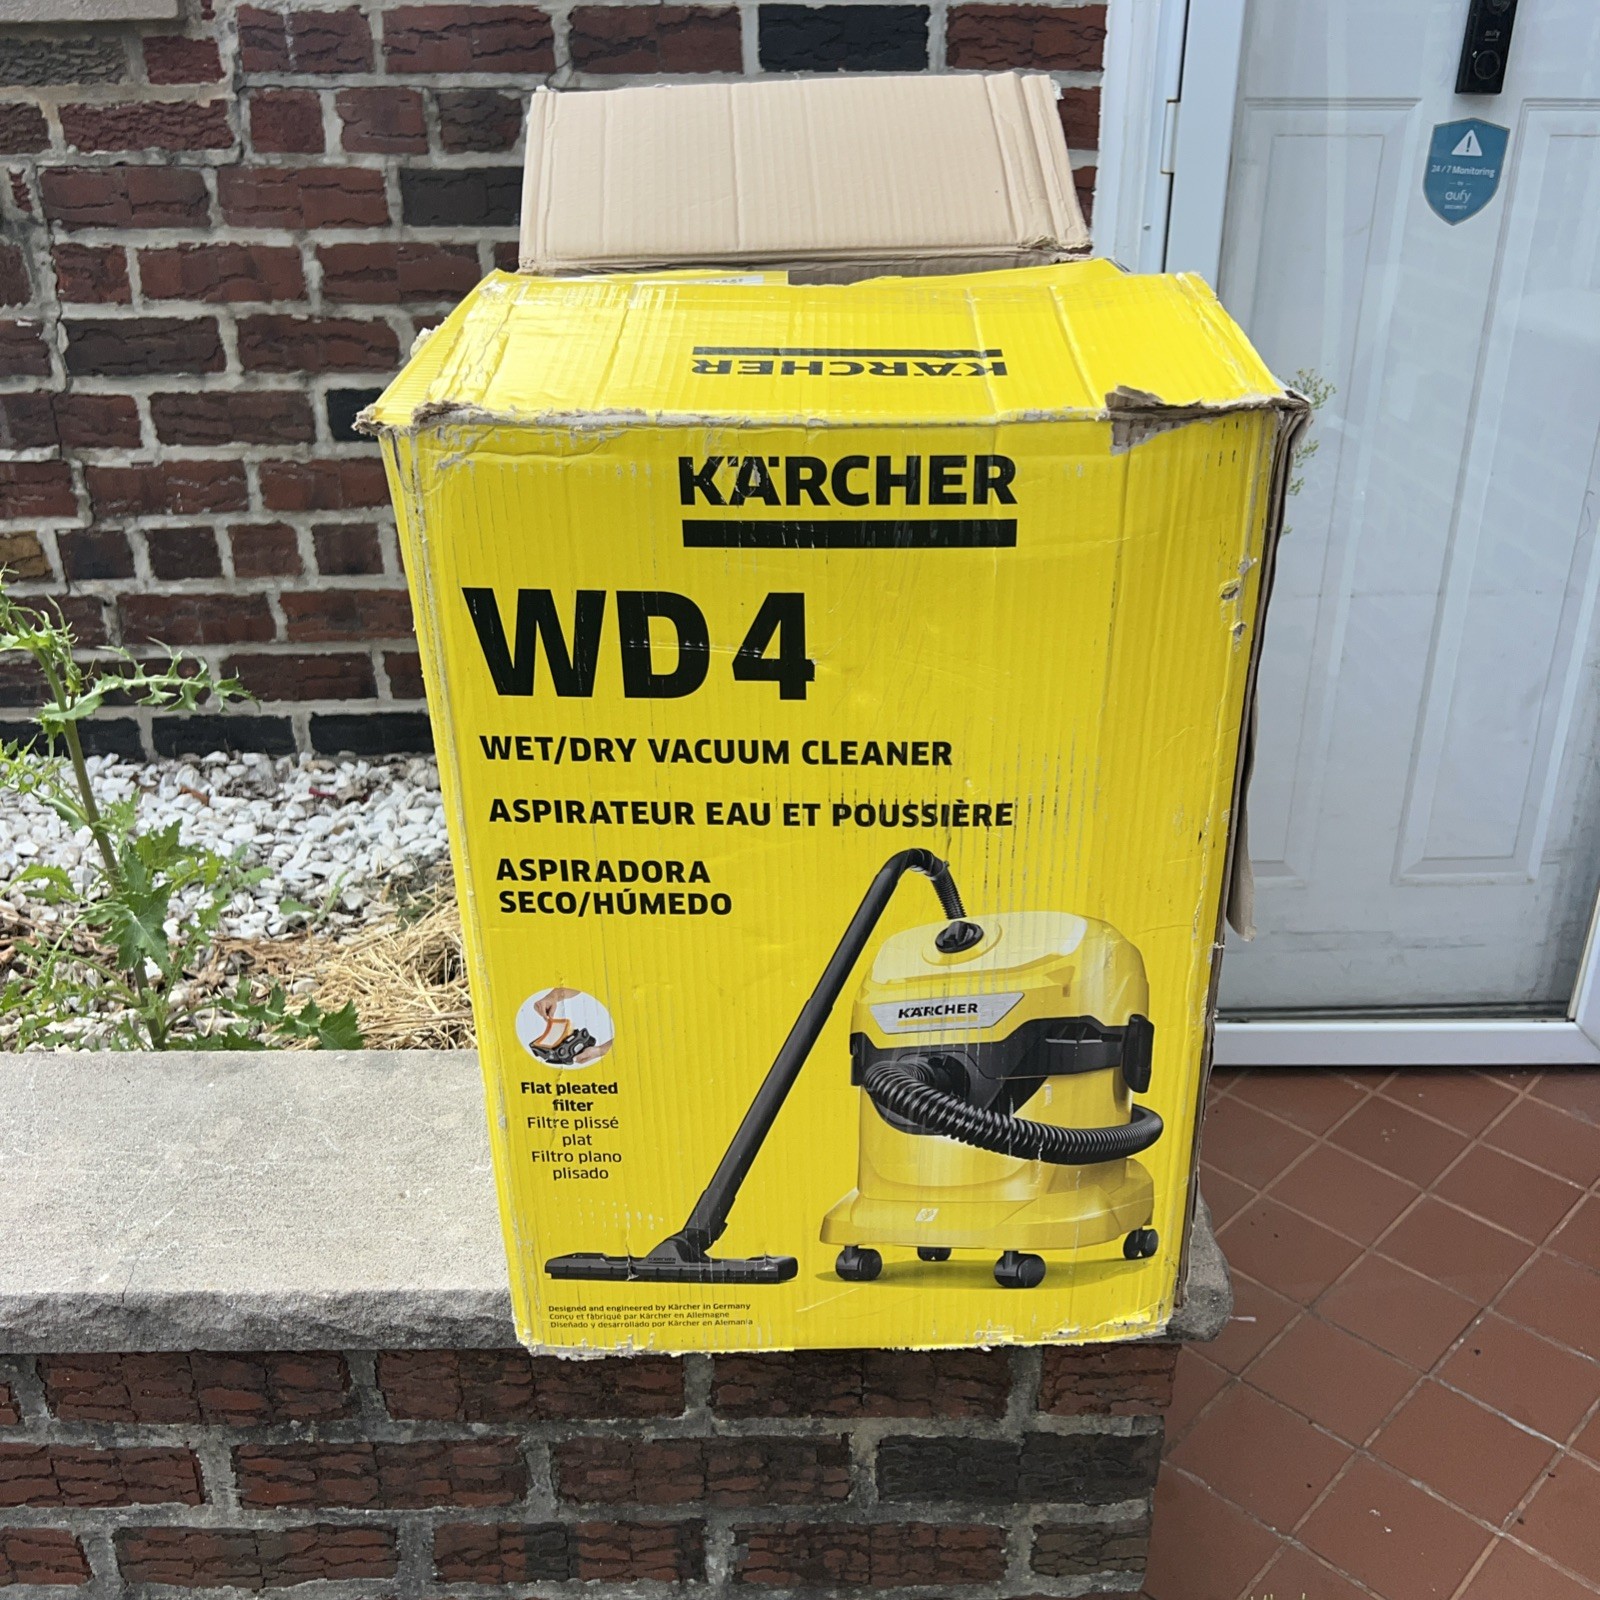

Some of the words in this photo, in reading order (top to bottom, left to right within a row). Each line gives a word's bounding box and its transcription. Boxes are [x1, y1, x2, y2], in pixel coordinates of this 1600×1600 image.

[1452, 165, 1496, 179] Monitoring
[1445, 189, 1472, 204] eufy
[691, 359, 1008, 377] KÄRCHER
[678, 455, 1018, 506] KÄRCHER
[462, 587, 709, 699] WD
[732, 592, 816, 701] 4
[480, 735, 637, 764] WET/DRY
[648, 738, 790, 764] VACUUM
[802, 740, 953, 766] CLEANER
[489, 798, 695, 826] ASPIRATEUR
[706, 802, 771, 826] EAU
[783, 803, 821, 827] ET
[832, 799, 1013, 828] POUSSIÈRE
[497, 859, 711, 884] ASPIRADORA
[499, 888, 733, 917] SECO/HÚMEDO
[898, 1003, 978, 1018] KÄRCHER
[520, 1081, 552, 1095] Flat
[556, 1081, 619, 1097] pleated
[552, 1098, 594, 1112] filter
[527, 1116, 570, 1129] Filtre
[574, 1116, 619, 1131] plissé
[562, 1133, 593, 1148] plat
[531, 1150, 574, 1163] Filtro
[578, 1150, 622, 1165] plano
[552, 1167, 609, 1181] plisado
[548, 1305, 587, 1313] Designed
[606, 1304, 653, 1313] engineered
[655, 1304, 666, 1312] by
[668, 1303, 701, 1311] Kärcher
[713, 1303, 751, 1311] Germany
[549, 1313, 574, 1321] Conçu
[623, 1313, 637, 1321] par
[639, 1312, 671, 1320] Kärcher
[686, 1311, 730, 1319] Allemagne
[668, 1319, 700, 1327] Kärcher
